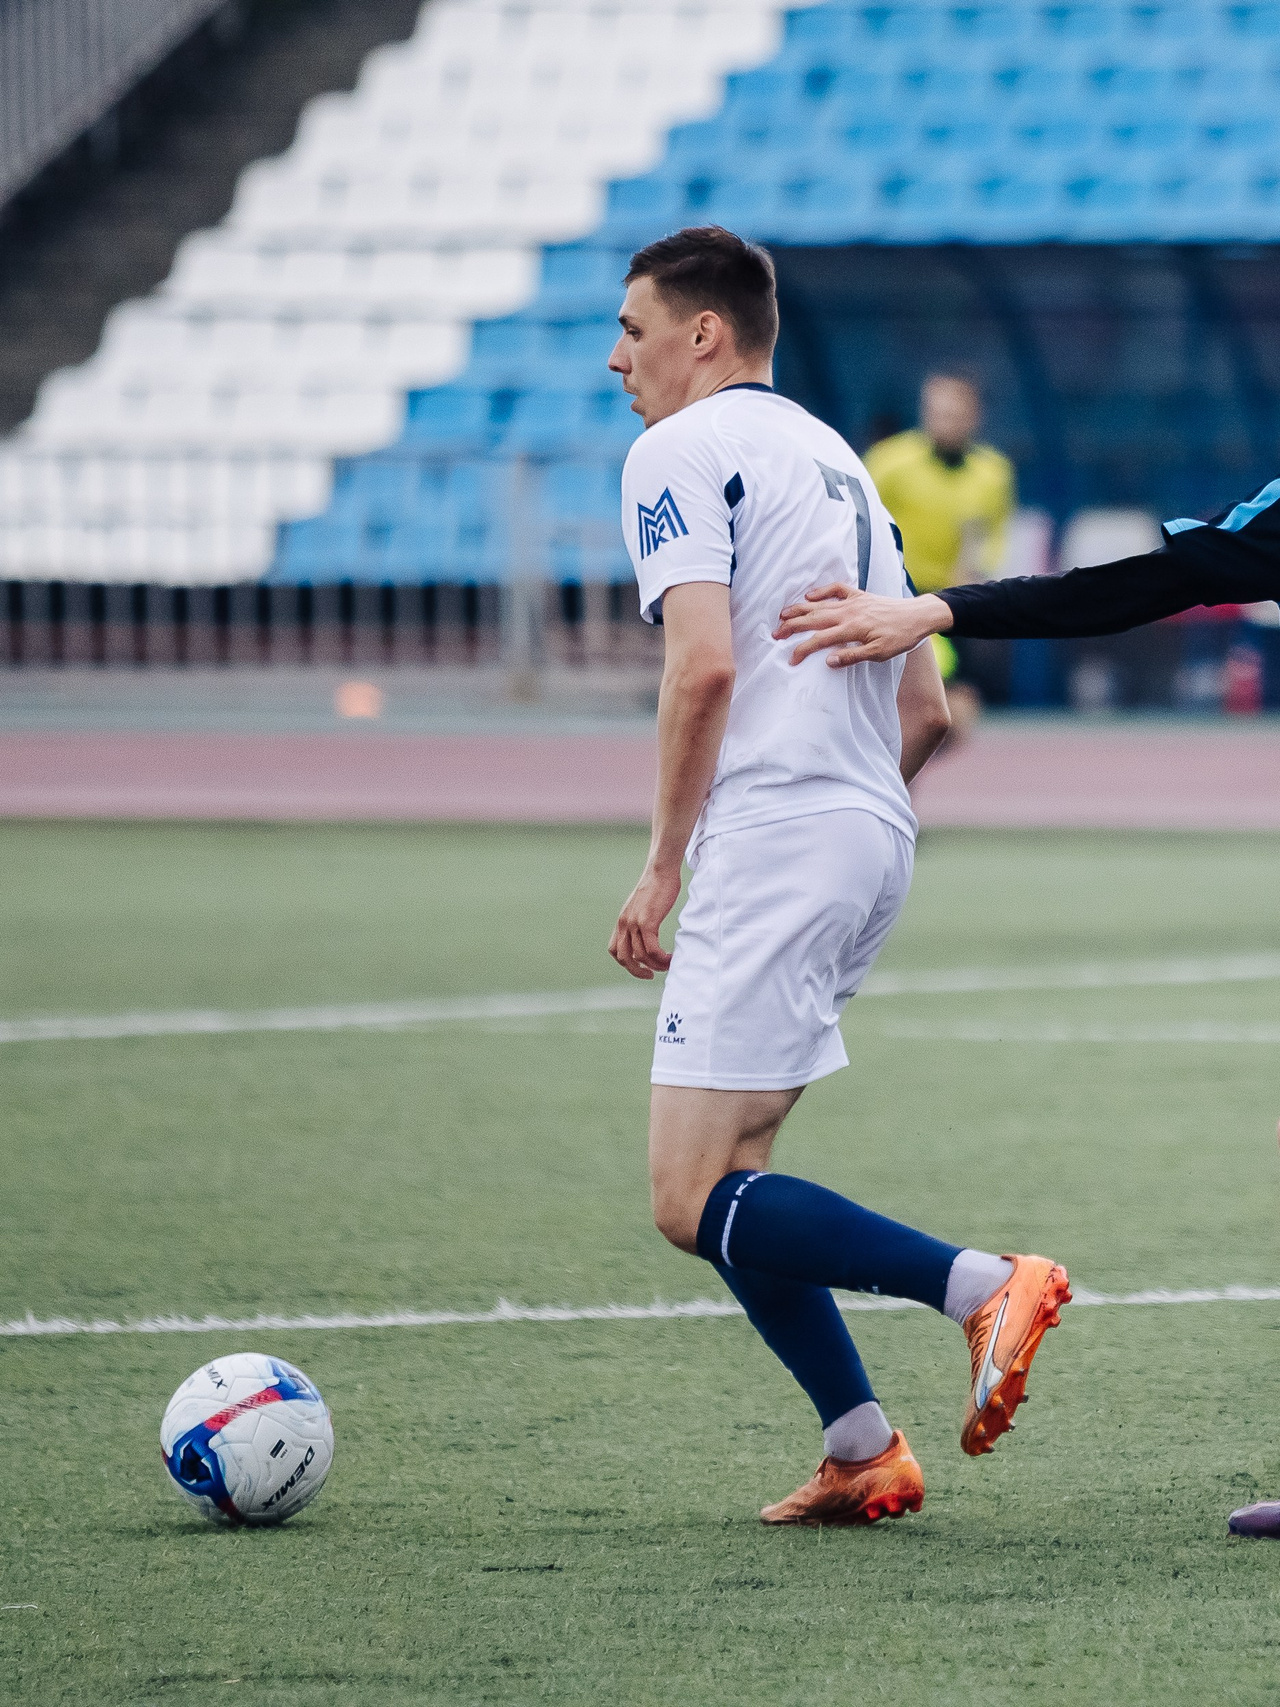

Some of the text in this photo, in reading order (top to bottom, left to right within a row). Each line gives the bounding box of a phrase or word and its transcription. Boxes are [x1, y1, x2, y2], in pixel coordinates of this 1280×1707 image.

[813, 458, 872, 592] 7
[658, 1035, 686, 1044] KELME
[261, 1445, 316, 1513] DEMIX
